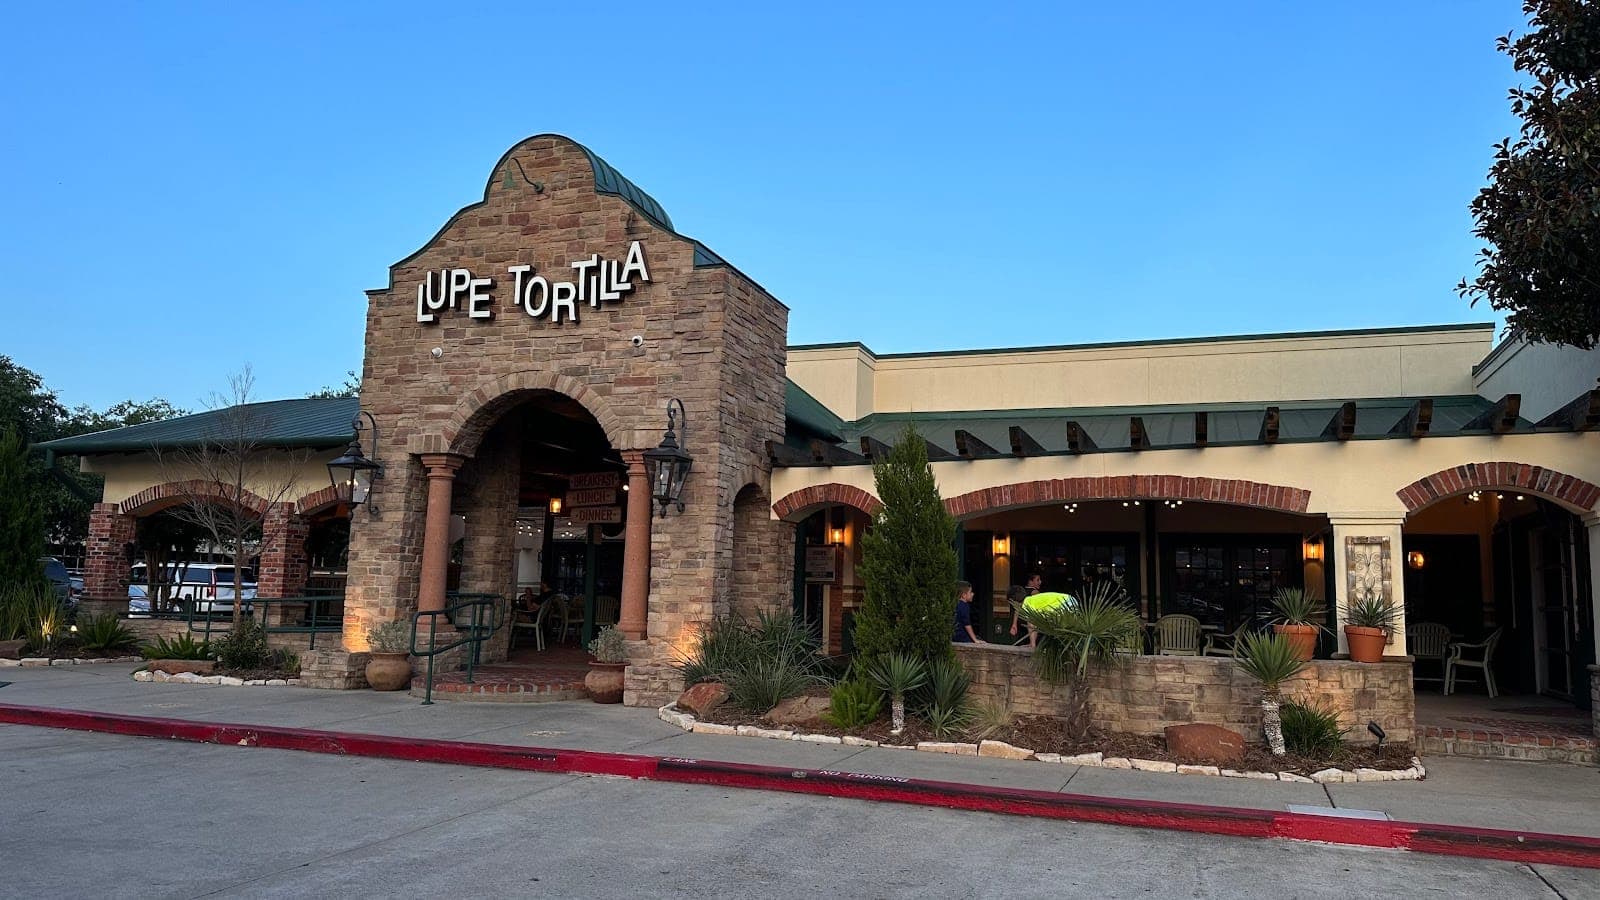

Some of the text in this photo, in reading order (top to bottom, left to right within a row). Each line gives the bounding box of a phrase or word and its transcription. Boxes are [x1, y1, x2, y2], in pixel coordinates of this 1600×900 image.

[417, 241, 649, 322] LUPE TORTILLA
[574, 473, 616, 488] BREAKFAST
[576, 490, 606, 504] LUNCH
[579, 509, 613, 521] DINNER
